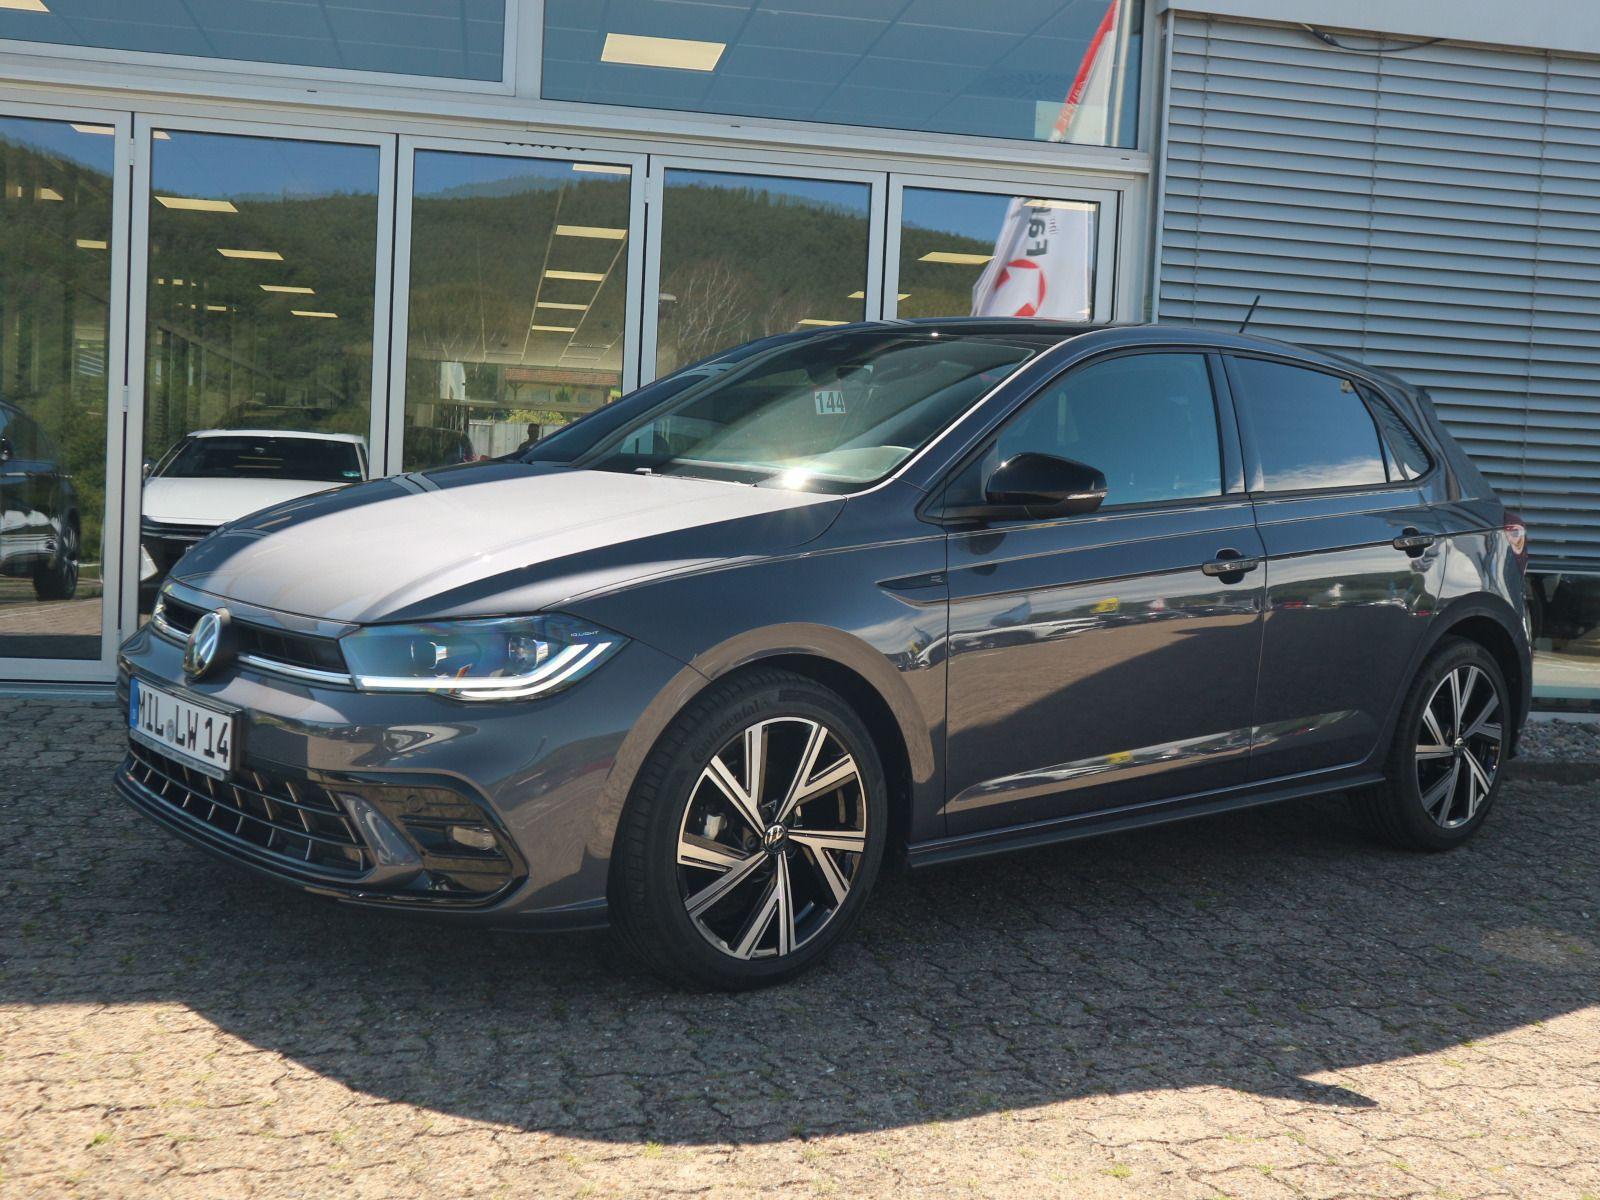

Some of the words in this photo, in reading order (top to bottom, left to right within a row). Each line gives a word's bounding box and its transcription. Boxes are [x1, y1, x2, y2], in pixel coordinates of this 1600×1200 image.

[816, 391, 847, 413] 144
[138, 685, 164, 737] MIL
[175, 704, 199, 752] LW
[203, 717, 229, 763] 14
